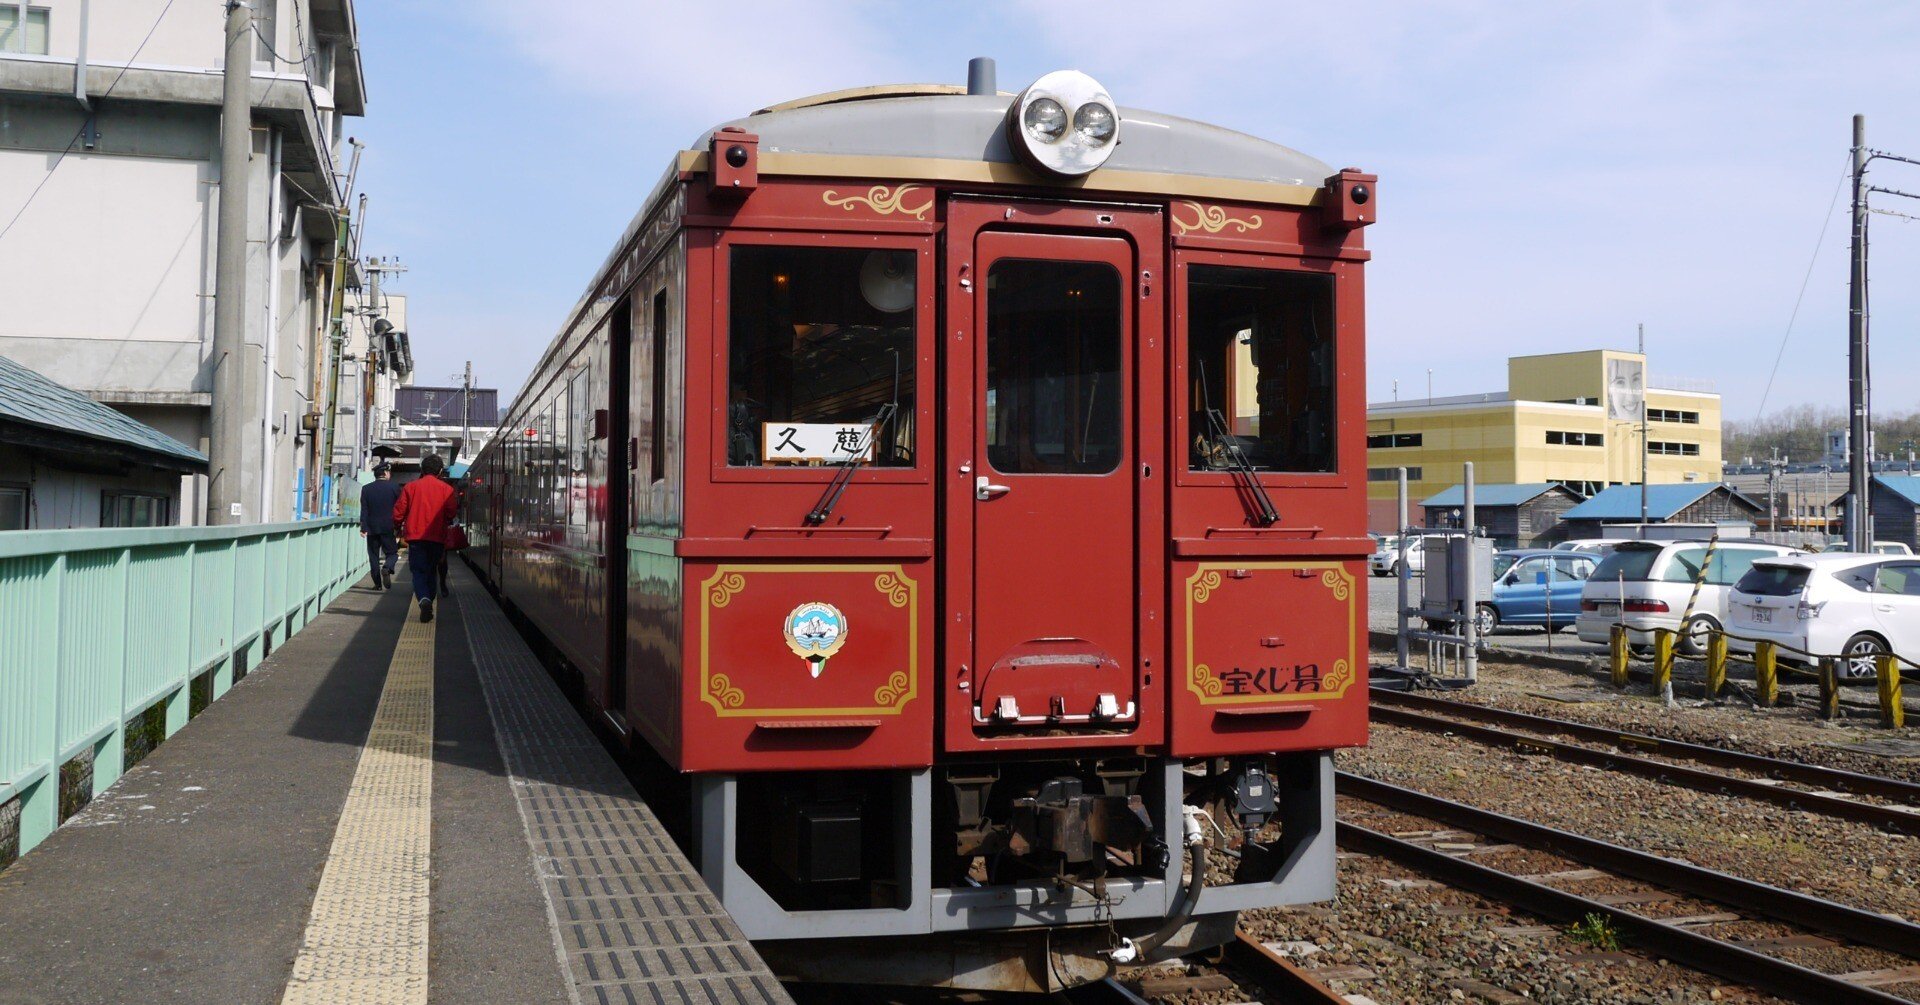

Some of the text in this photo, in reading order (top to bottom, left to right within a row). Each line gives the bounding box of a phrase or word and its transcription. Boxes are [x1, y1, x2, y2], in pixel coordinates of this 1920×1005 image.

[774, 427, 864, 454] 久慈
[1219, 663, 1323, 695] 宝くじ号
